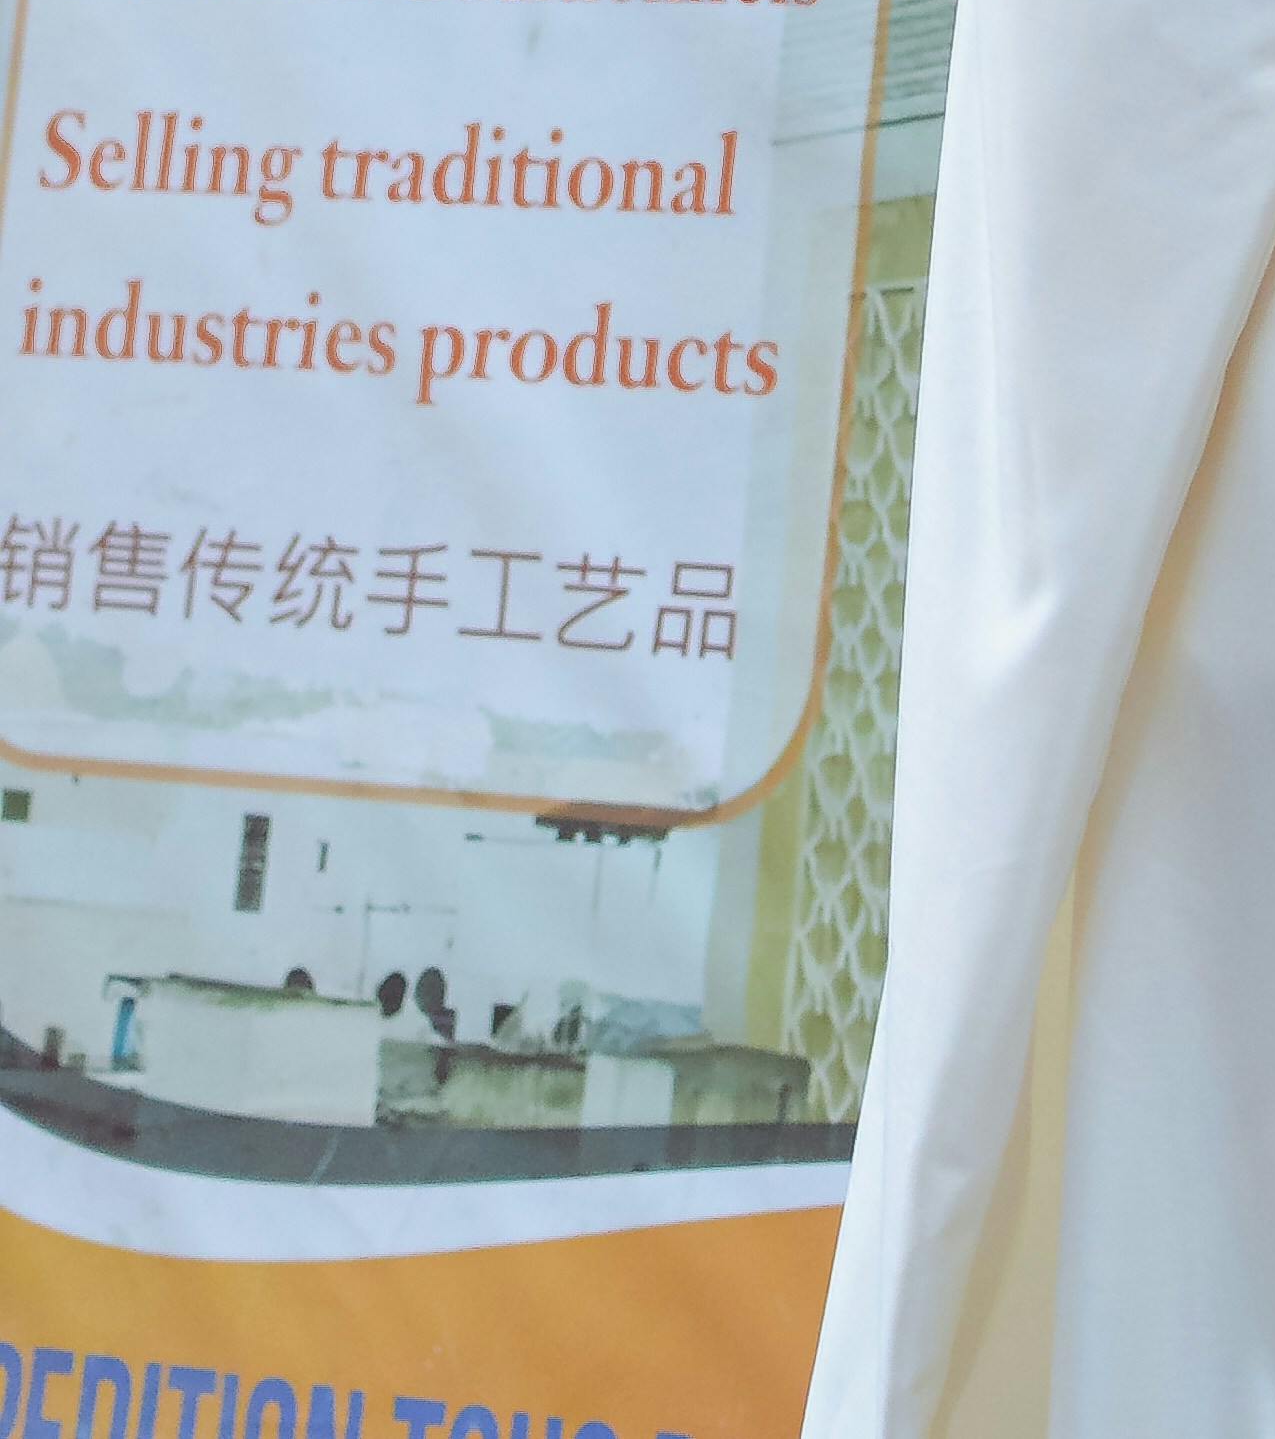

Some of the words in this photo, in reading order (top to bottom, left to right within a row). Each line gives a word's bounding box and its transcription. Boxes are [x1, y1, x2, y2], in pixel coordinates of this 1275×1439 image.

[37, 110, 302, 225] Selling
[320, 122, 738, 215] traditional
[17, 278, 397, 375] industries
[419, 302, 781, 405] products
[0, 514, 738, 661] 销售传统手工艺品
